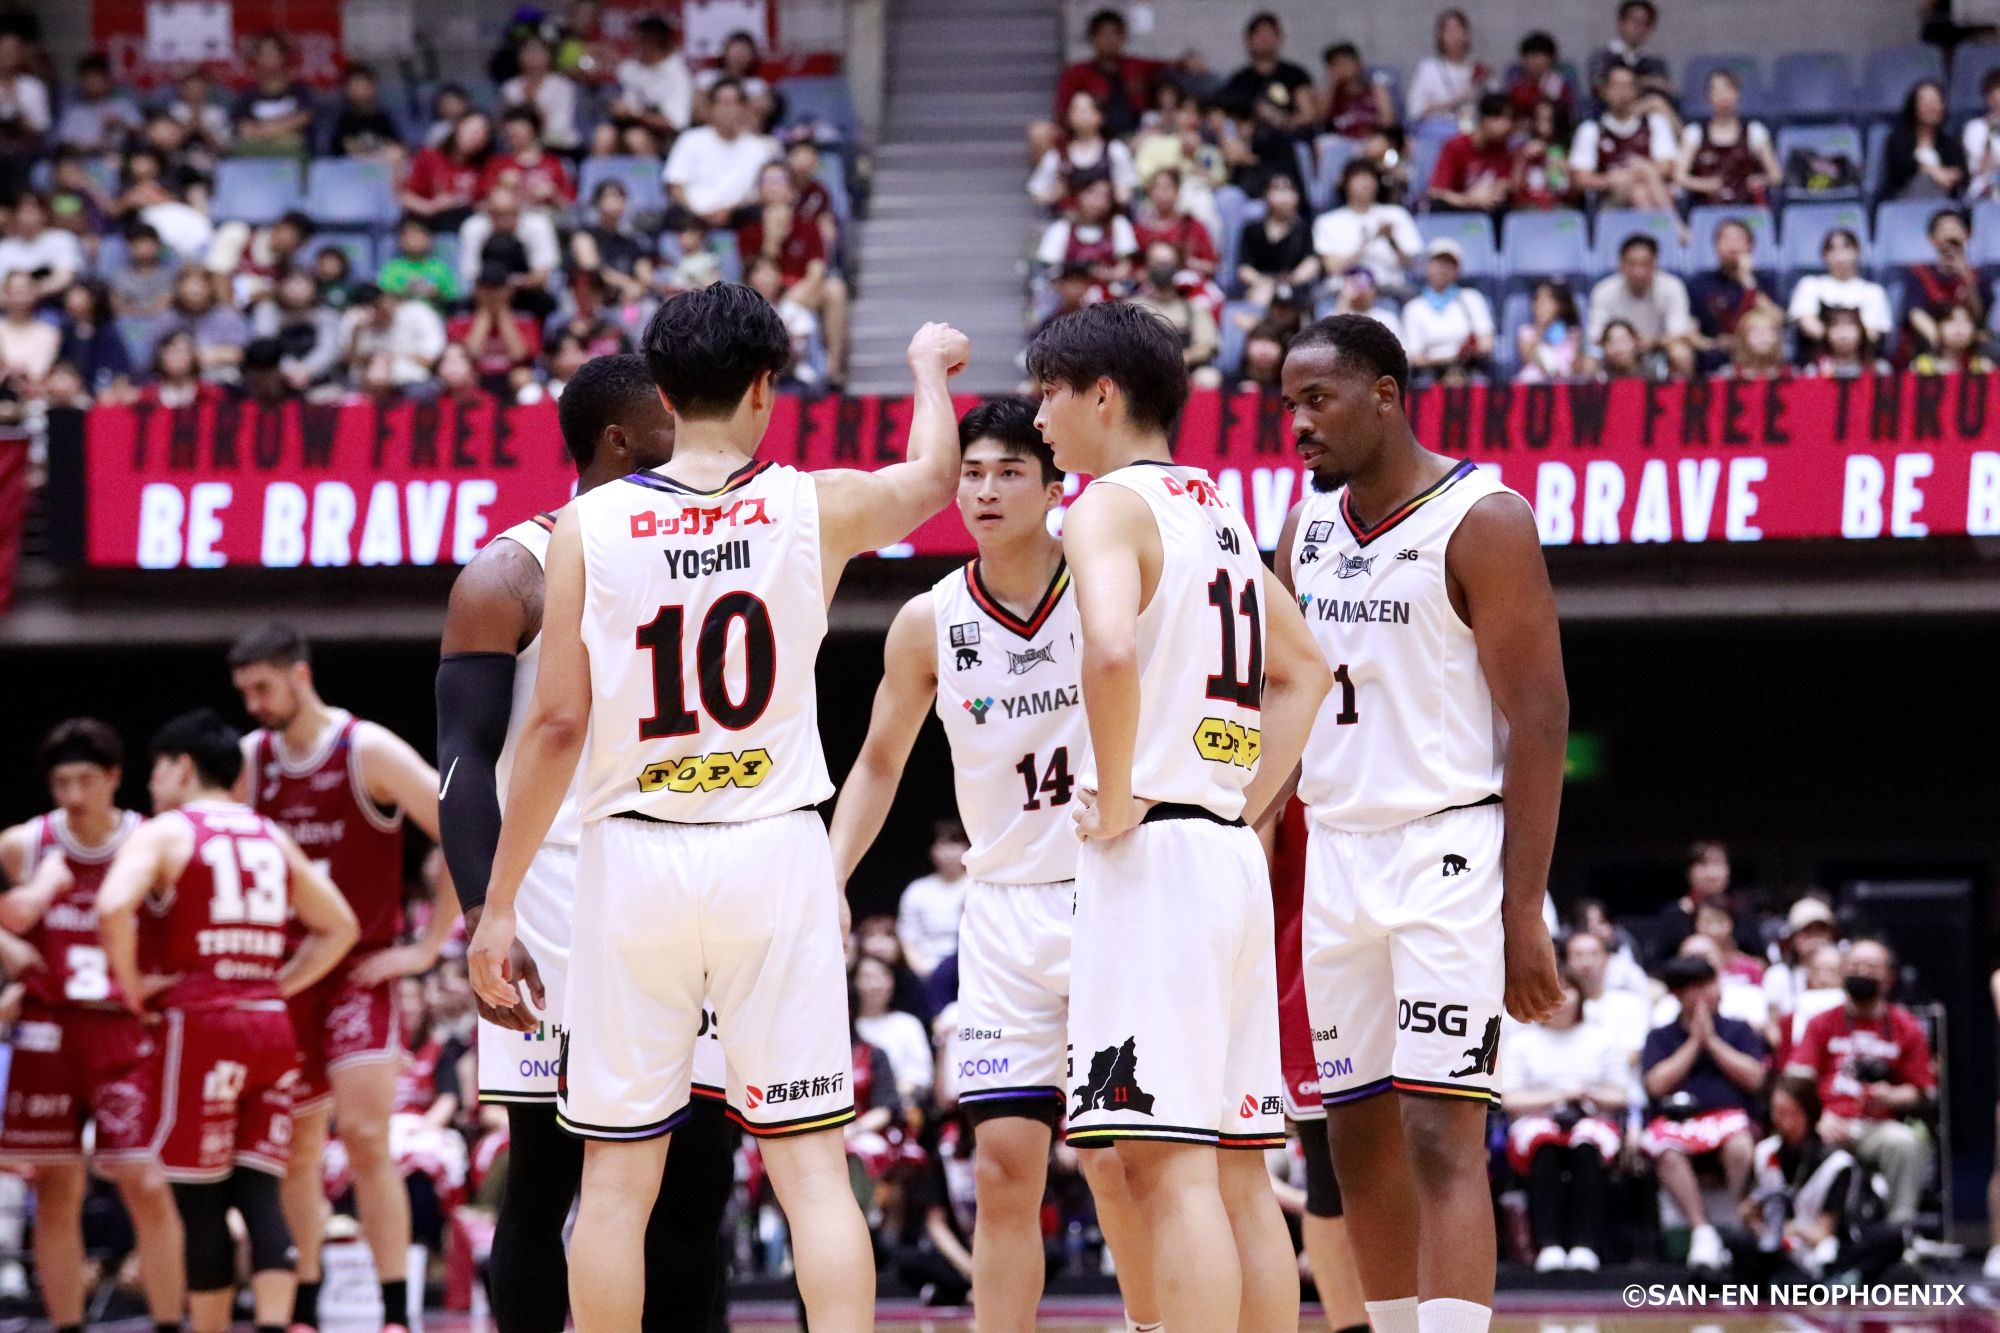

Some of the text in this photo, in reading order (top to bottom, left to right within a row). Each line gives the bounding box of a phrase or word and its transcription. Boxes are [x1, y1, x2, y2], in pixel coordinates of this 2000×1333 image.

[1535, 456, 1768, 546] BRAVE
[1841, 452, 1935, 539] BE
[136, 479, 497, 570] BE BRAVE
[663, 540, 751, 580] YOSHII
[1395, 548, 1419, 561] SG
[1316, 597, 1410, 625] YAMAZEN
[635, 590, 776, 742] 10
[1205, 568, 1261, 712] 11
[1333, 663, 1359, 726] 1
[645, 757, 764, 786] TOPY
[1015, 745, 1075, 812] 14
[201, 834, 286, 926] 13
[65, 944, 110, 1000] 3
[1398, 998, 1469, 1038] OSG
[765, 1071, 845, 1105] 西鉄旅行
[1113, 1086, 1129, 1103] 11
[1260, 1095, 1285, 1115] 西
